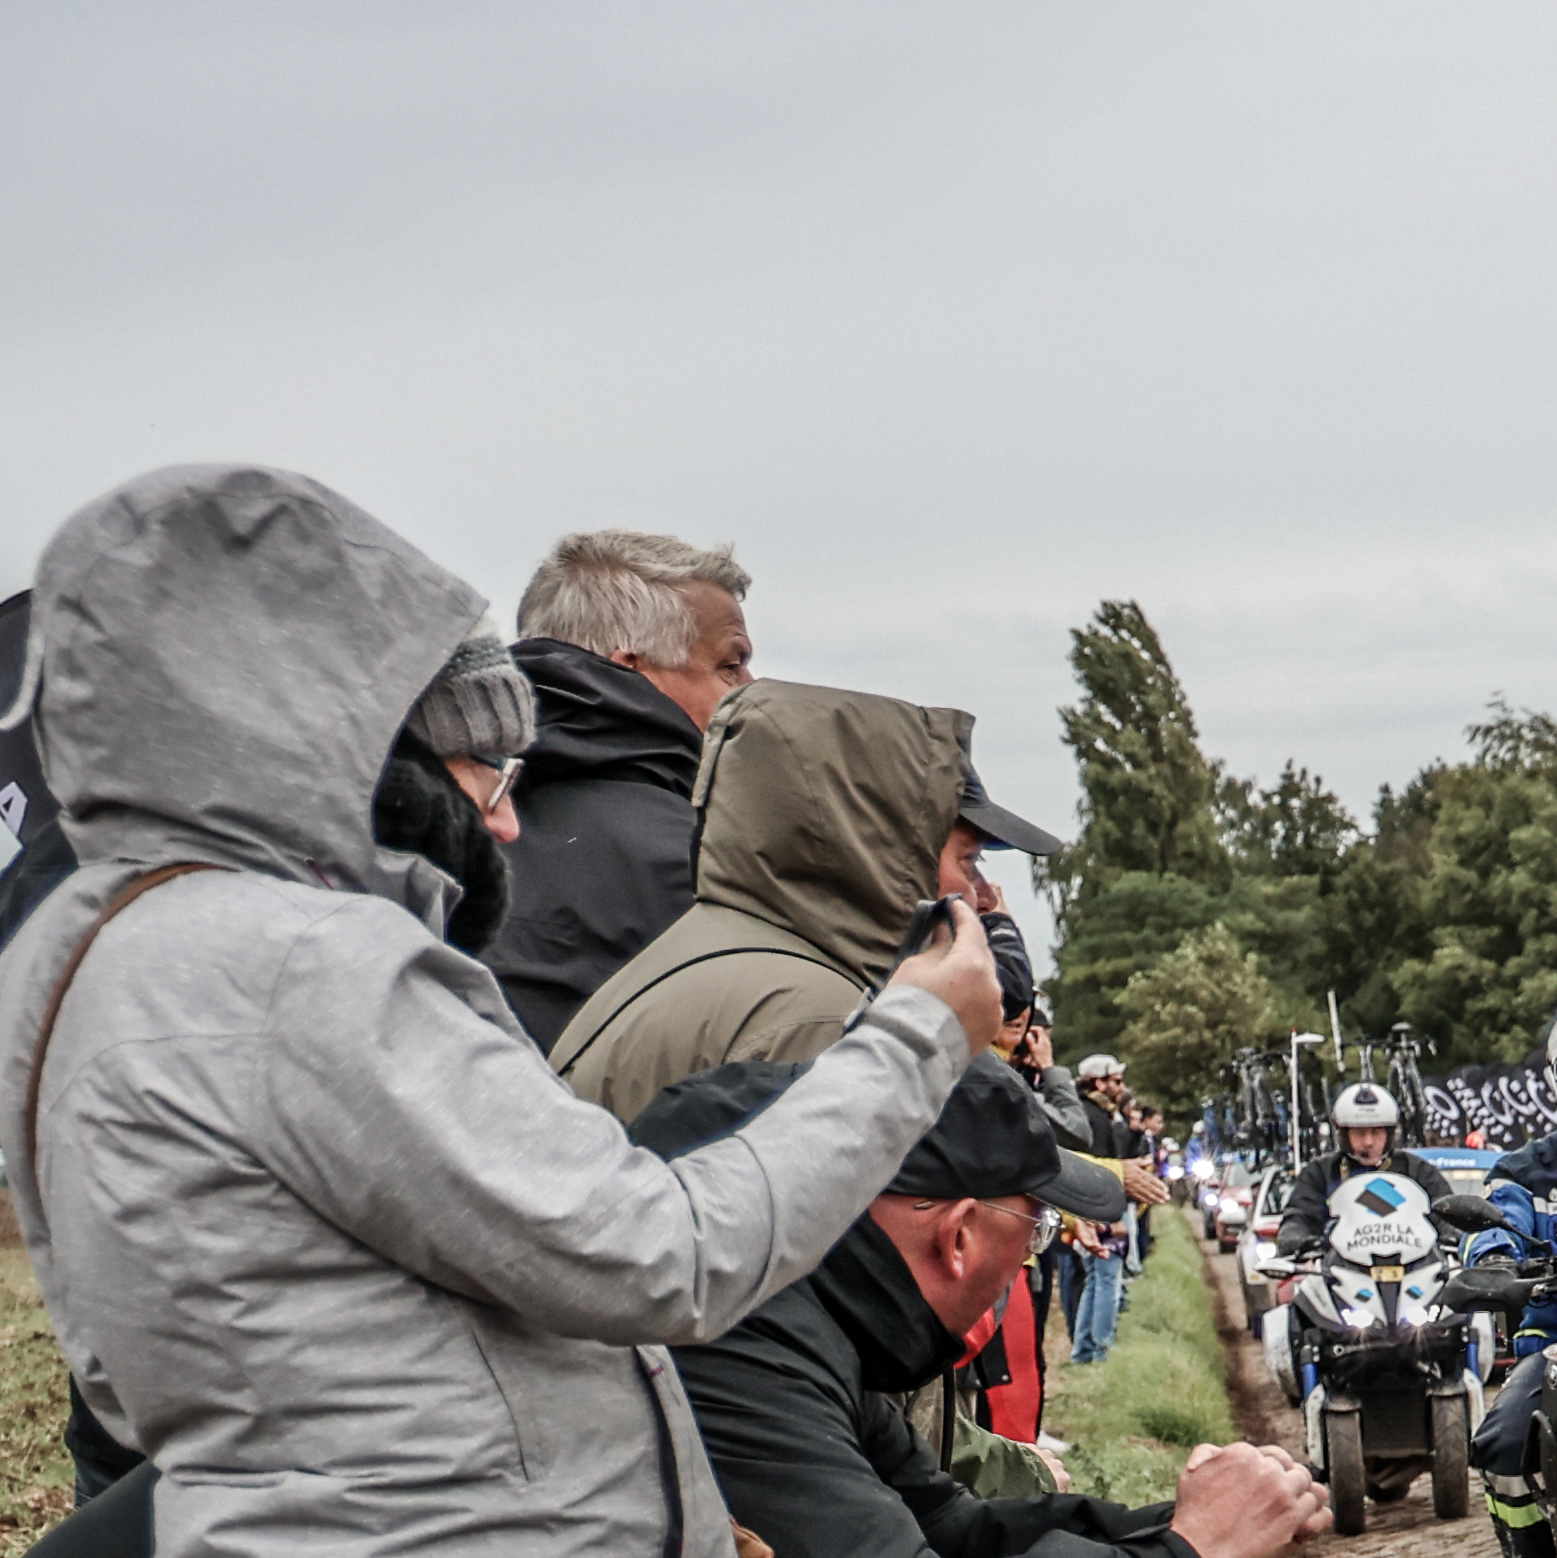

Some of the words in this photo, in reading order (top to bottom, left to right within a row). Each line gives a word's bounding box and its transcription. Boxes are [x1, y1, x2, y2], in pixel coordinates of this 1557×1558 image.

[1353, 1223, 1393, 1238] AG2R
[1396, 1223, 1415, 1236] LA
[1346, 1233, 1423, 1251] MONDIALE
